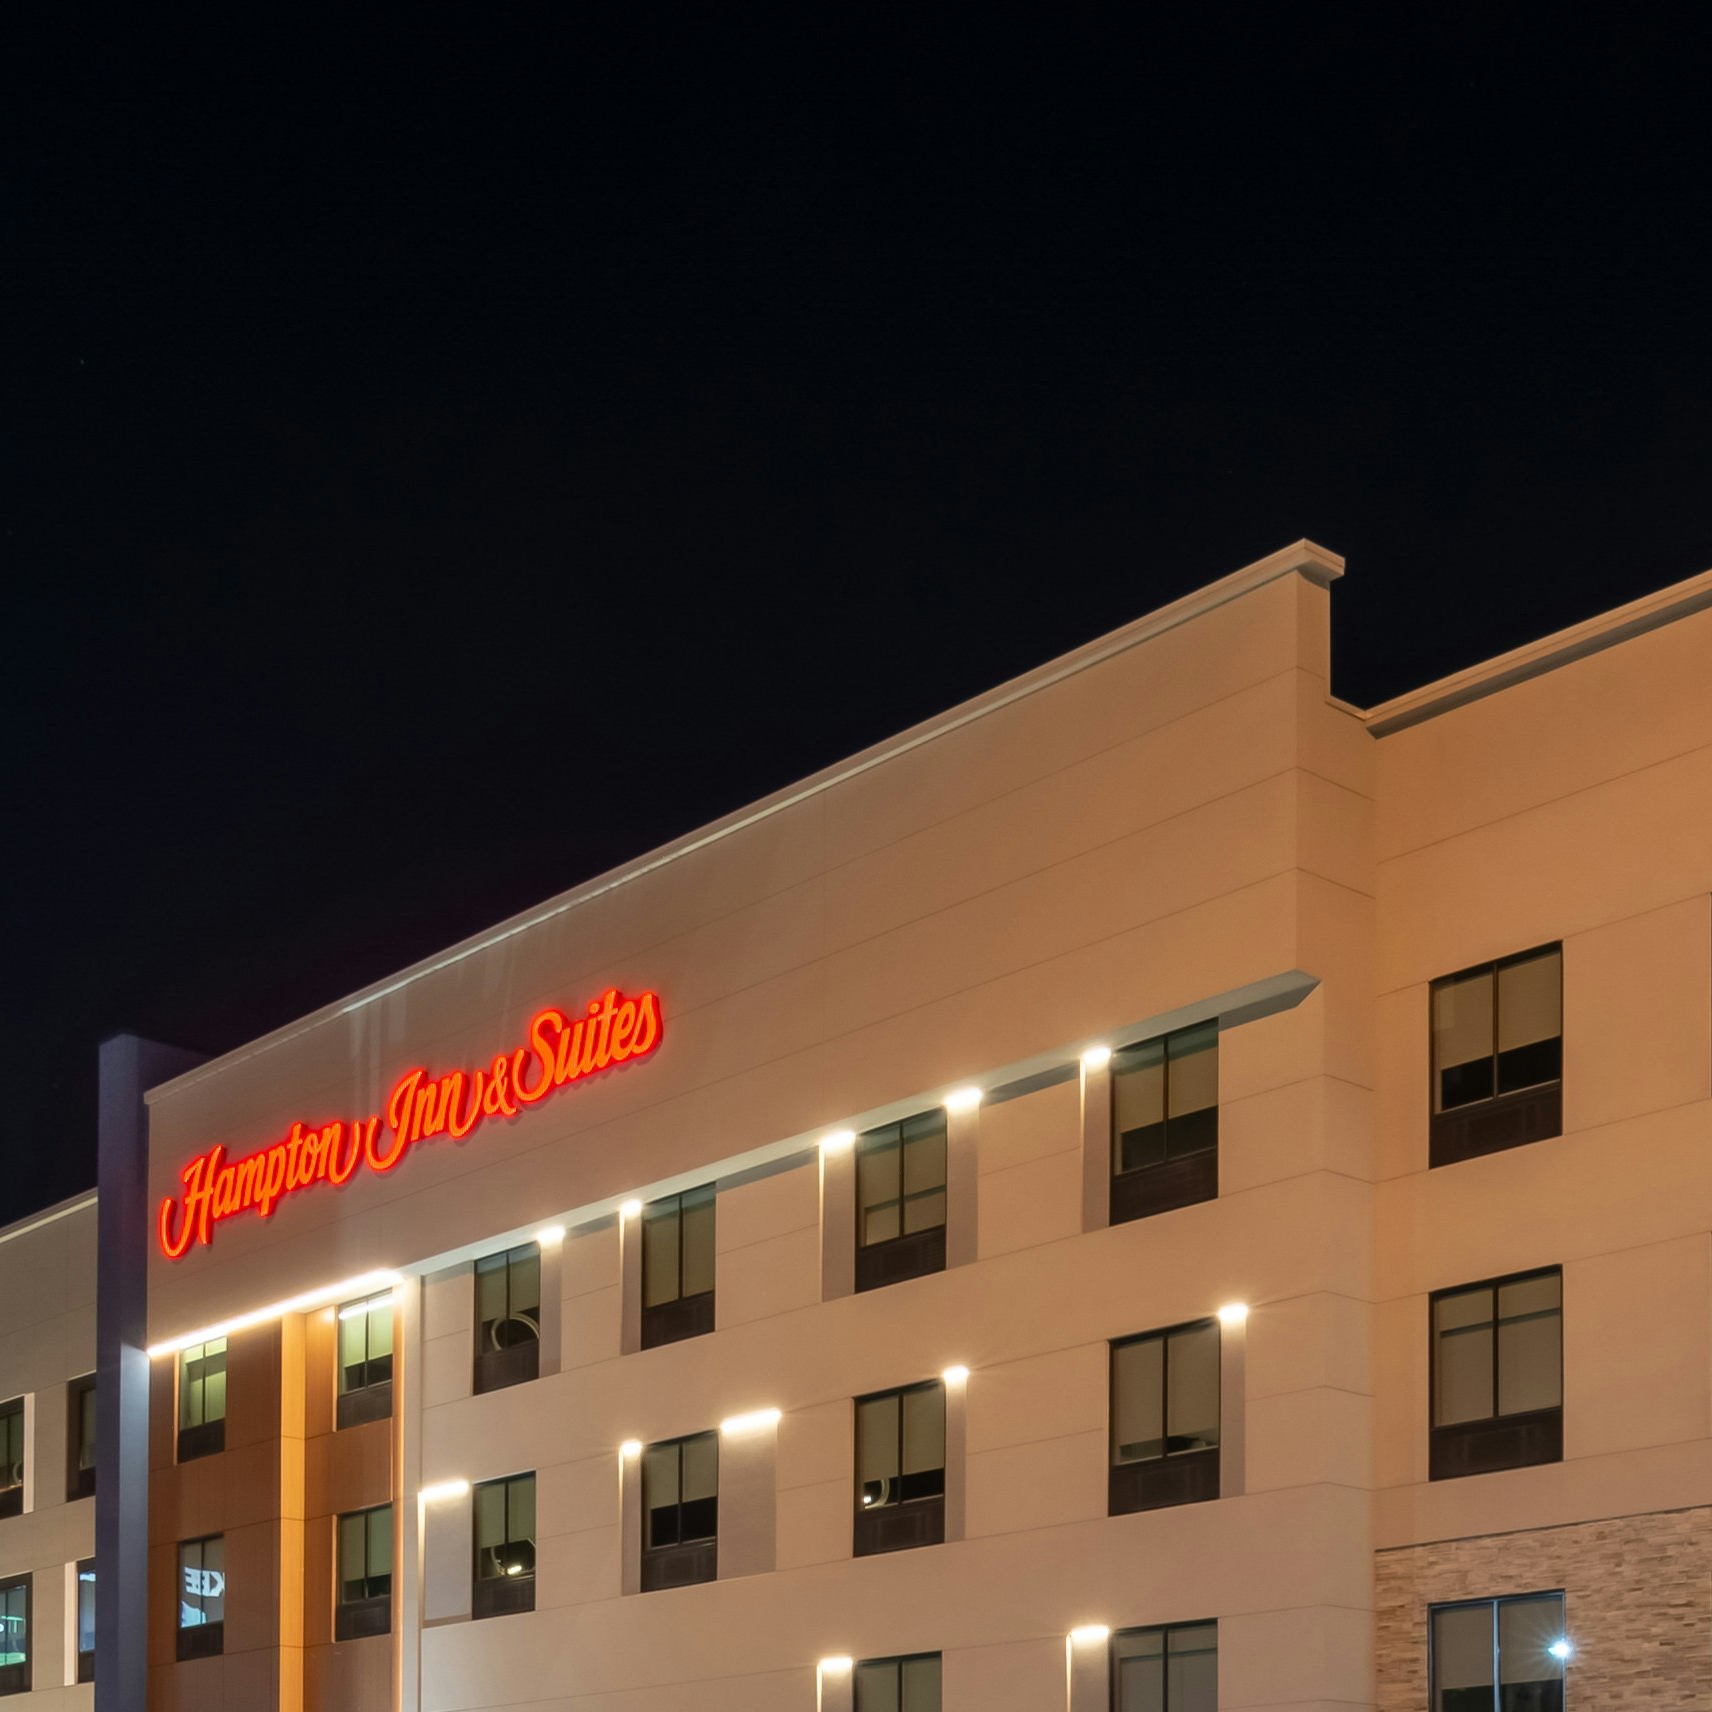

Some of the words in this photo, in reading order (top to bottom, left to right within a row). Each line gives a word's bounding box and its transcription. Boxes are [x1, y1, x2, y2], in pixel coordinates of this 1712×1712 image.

[160, 1121, 361, 1259] Hampton
[365, 1068, 485, 1171] Inn
[483, 1056, 518, 1116] &
[511, 988, 663, 1102] Suites
